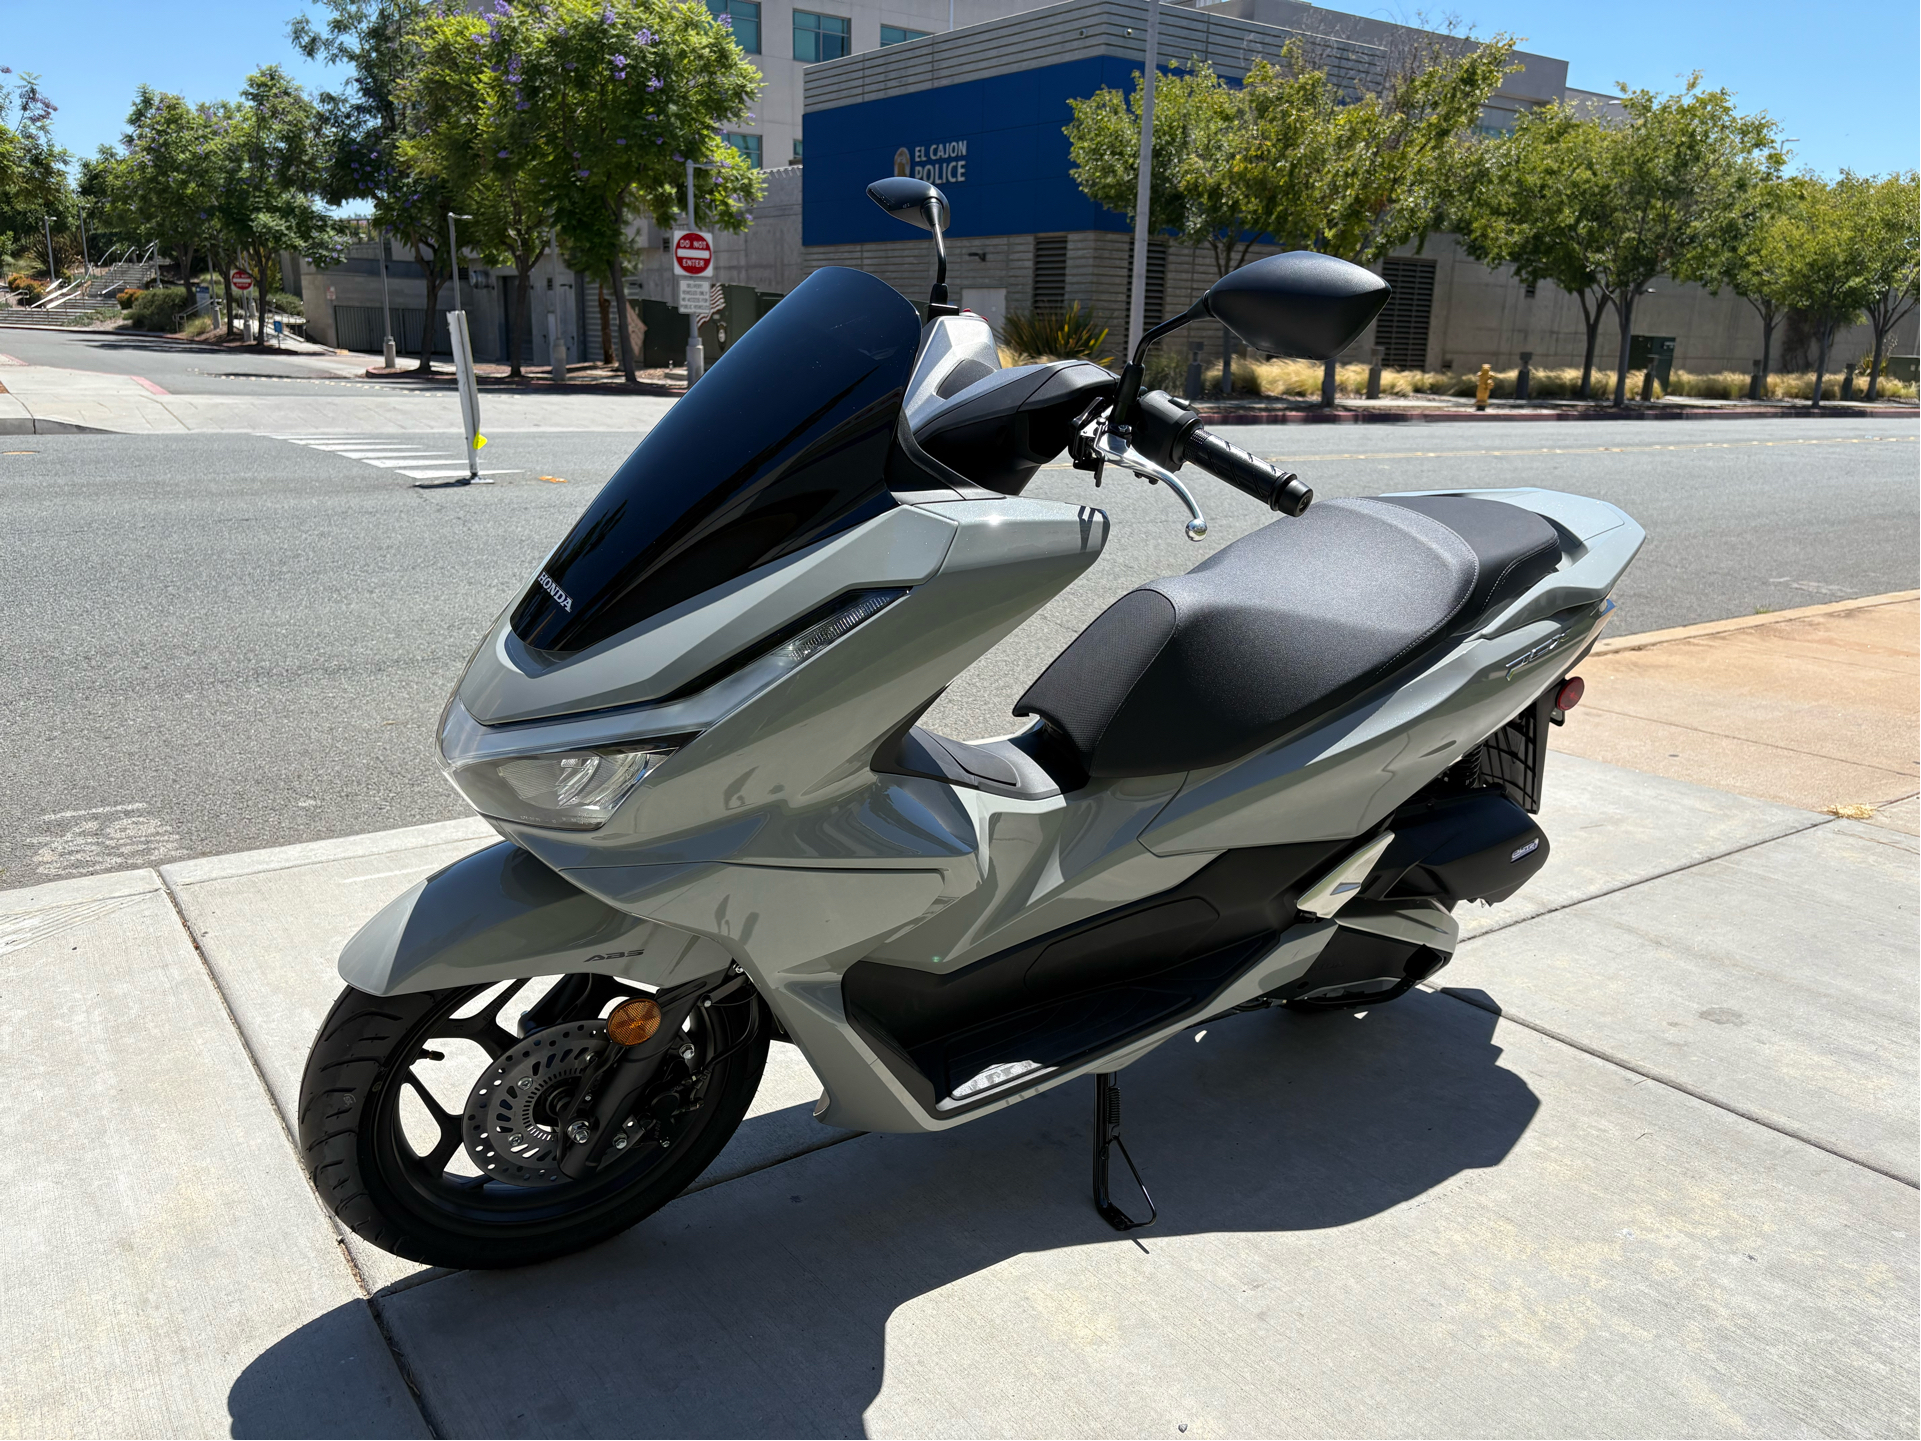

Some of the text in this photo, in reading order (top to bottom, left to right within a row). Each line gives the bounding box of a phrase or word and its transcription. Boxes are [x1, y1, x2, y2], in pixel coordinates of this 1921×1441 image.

[915, 140, 967, 161] EL CAJON
[915, 161, 966, 184] POLICE
[680, 240, 706, 249] DO NOT
[683, 259, 704, 267] ENTER
[538, 571, 573, 613] HONDA
[583, 949, 645, 962] ABS
